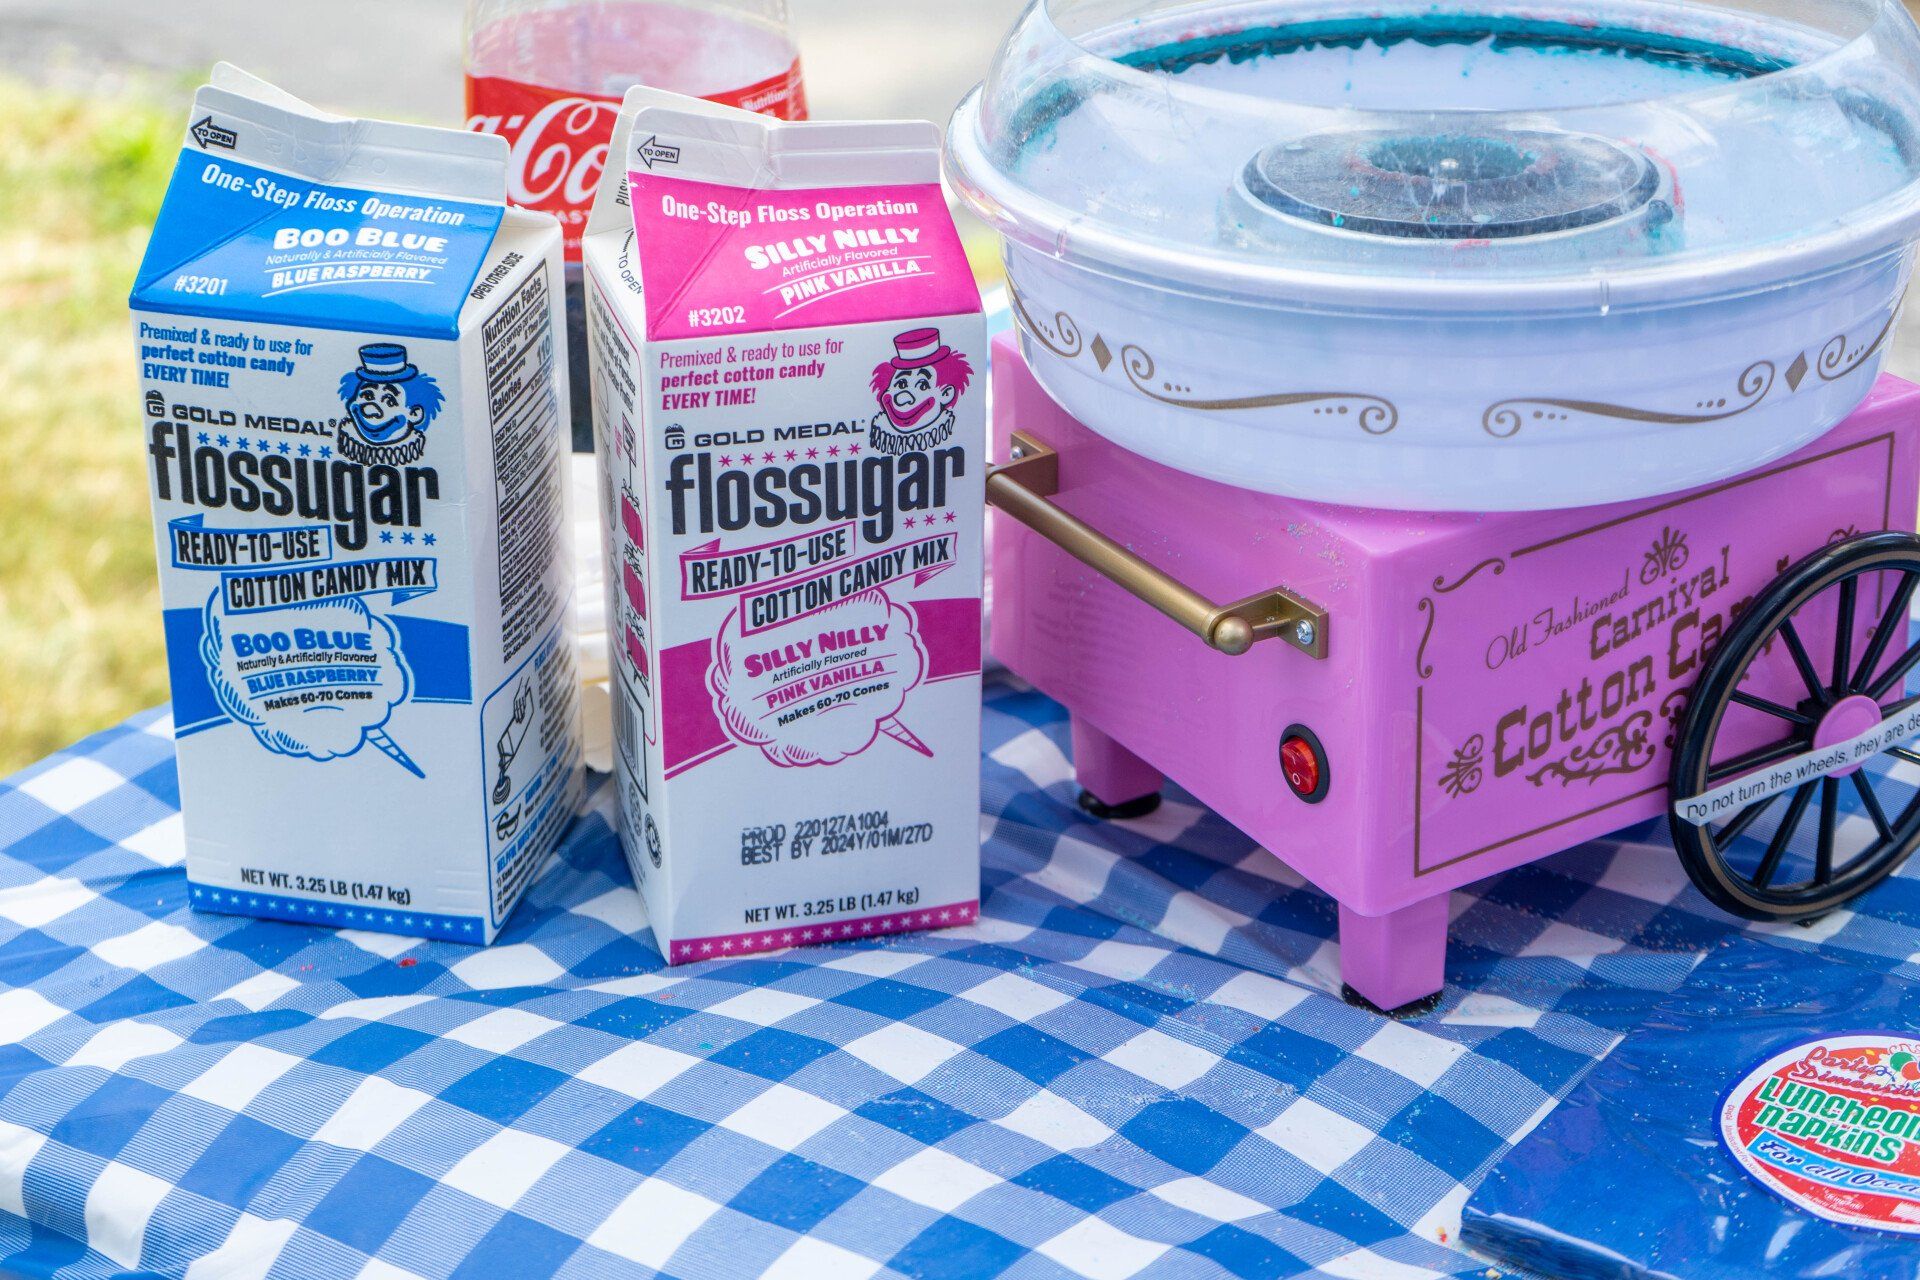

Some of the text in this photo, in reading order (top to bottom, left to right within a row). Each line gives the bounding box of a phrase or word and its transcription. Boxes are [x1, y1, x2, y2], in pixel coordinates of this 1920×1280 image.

[197, 128, 233, 144] TO OPEN
[643, 148, 676, 160] TO OPEN
[201, 163, 465, 226] One-Step Floss Operation
[661, 194, 918, 228] One-Step Floss Operation
[265, 249, 448, 266] Naturally & Artificially Flavored
[273, 227, 448, 252] BOO BLUE
[744, 228, 920, 270] SILLY NILLY
[271, 265, 431, 288] BLUE RASPBERRY
[470, 252, 524, 300] OPEN OTHER SIDE
[618, 252, 643, 295] TO OPEN
[782, 246, 898, 278] Artificially Flavored
[173, 274, 228, 296] #3201
[780, 259, 921, 306] PINK VANILLA
[484, 301, 521, 346] Nutrition
[521, 276, 542, 308] Facts
[688, 305, 746, 327] #3202
[140, 322, 313, 356] Premixed & ready to use for
[661, 338, 844, 369] Premixed & ready to use for
[141, 344, 295, 376] perfect cotton candy
[143, 362, 230, 389] EVERY TIME!
[661, 359, 825, 392] perfect cotton candy
[491, 369, 521, 419] Calories
[662, 388, 756, 411] EVERY TIME!
[172, 404, 237, 427] GOLD
[694, 429, 765, 447] GOLD
[149, 420, 440, 551] flossugar
[665, 445, 965, 544] flossugar
[177, 529, 320, 565] READY-TO-USE
[692, 528, 847, 594] READY-TO-USE
[229, 559, 426, 608] COTTON CANDY MIX
[751, 537, 950, 628] COTTON CANDY MIX
[1485, 624, 1528, 670] Old
[1533, 567, 1630, 647] Fashioned
[1590, 544, 1730, 660] Carnival
[231, 628, 373, 657] BOO BLUE
[744, 624, 889, 678] SILLY NILLY
[236, 652, 378, 672] Naturally & Artificially Flavored
[772, 647, 867, 684] Artificially Flavored
[247, 669, 378, 694] BLUE RASPBERRY
[766, 660, 884, 709] PINK VANILLA
[264, 689, 373, 711] Makes 60-70 Cones
[777, 681, 890, 727] Makes 60-70 Cones
[1492, 655, 1656, 778] Cotton
[1712, 790, 1735, 812] not
[1739, 781, 1766, 801] turn
[1770, 771, 1793, 790] the
[1797, 751, 1849, 779] wheels,
[1854, 734, 1881, 757] they
[1885, 724, 1904, 743] are
[741, 811, 889, 846] PROD 220127A1004
[741, 823, 933, 866] BEST BY 2024Y/01M/27D
[240, 867, 411, 906] NET WT. 3.25 LB (1.47 kg)
[745, 887, 920, 923] NET WT. 3.25 LB (1.47 kg)
[1798, 1046, 1878, 1079] Party
[1756, 1105, 1902, 1162] napkins
[1760, 1141, 1803, 1165] For
[1805, 1165, 1851, 1179] all
